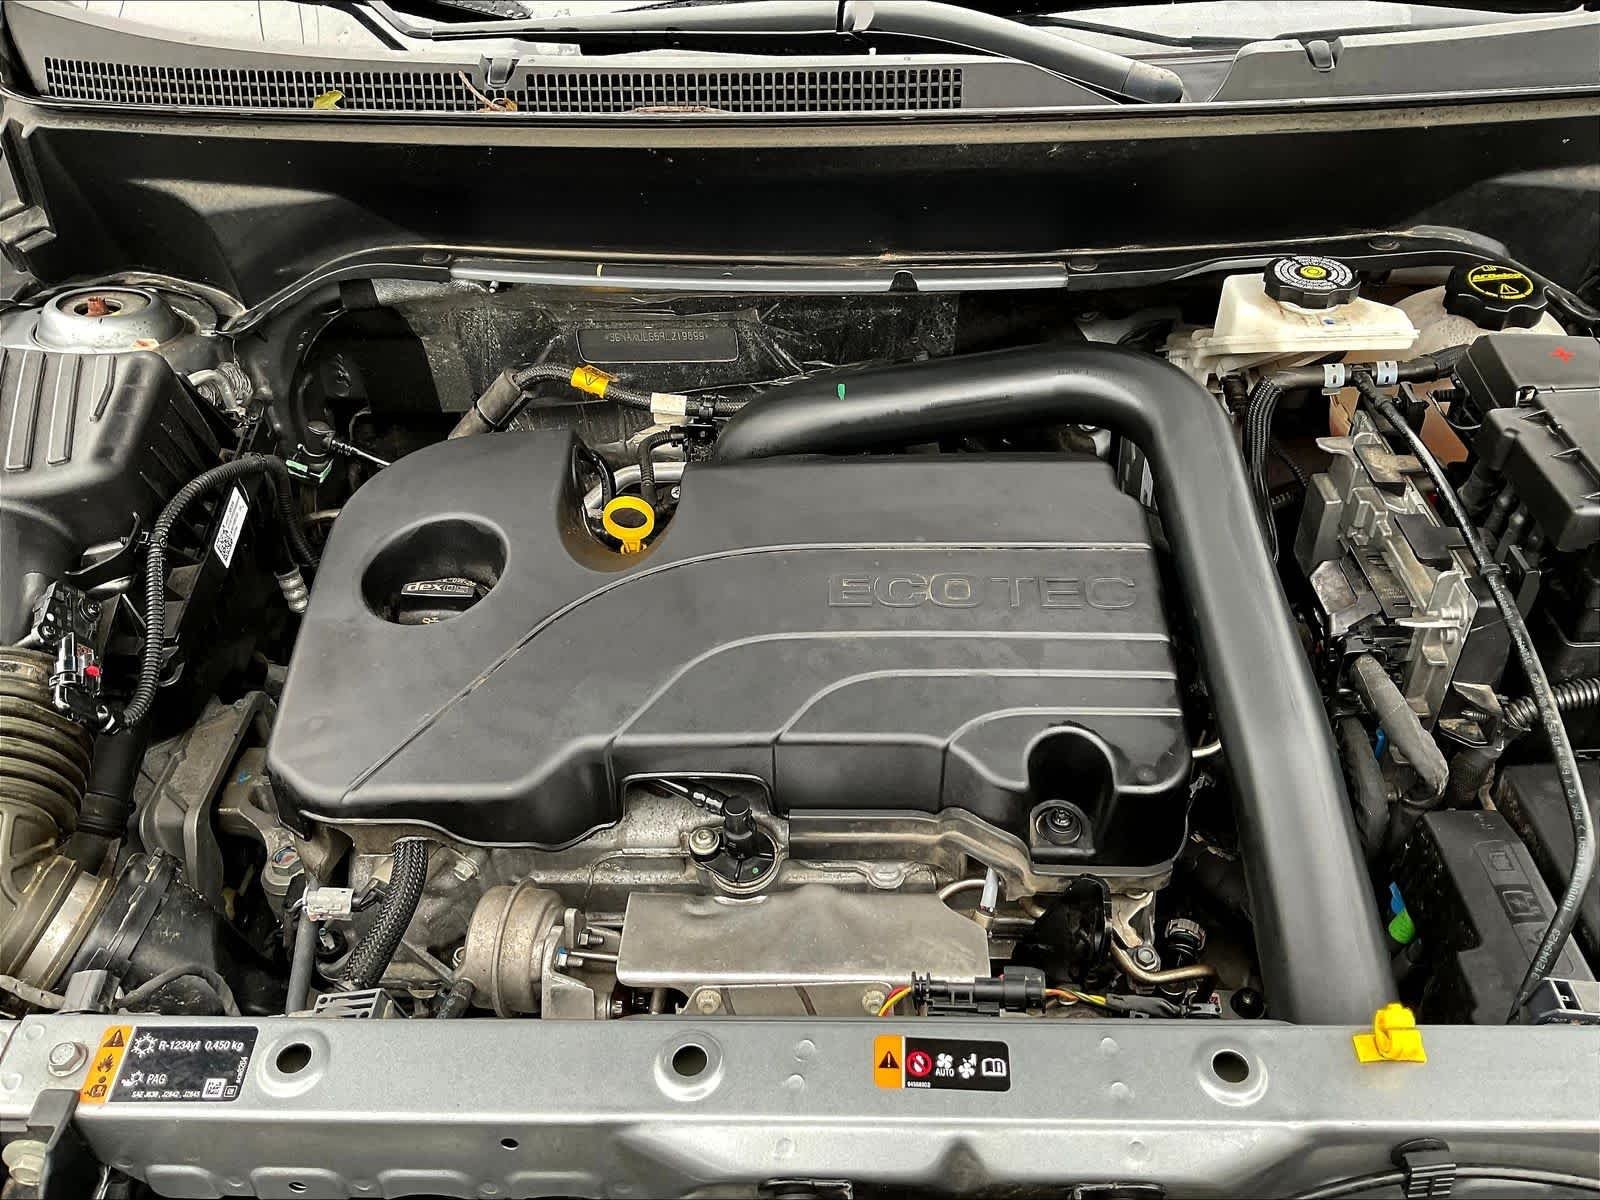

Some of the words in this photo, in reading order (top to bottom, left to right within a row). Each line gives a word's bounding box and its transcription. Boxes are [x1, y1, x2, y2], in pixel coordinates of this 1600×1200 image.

[828, 573, 1137, 610] ECOTEC
[158, 1040, 201, 1052] R-1234yf
[204, 1040, 230, 1050] 0.450
[231, 1039, 244, 1051] kg
[935, 1068, 955, 1077] AUTO
[146, 1073, 167, 1085] PAG
